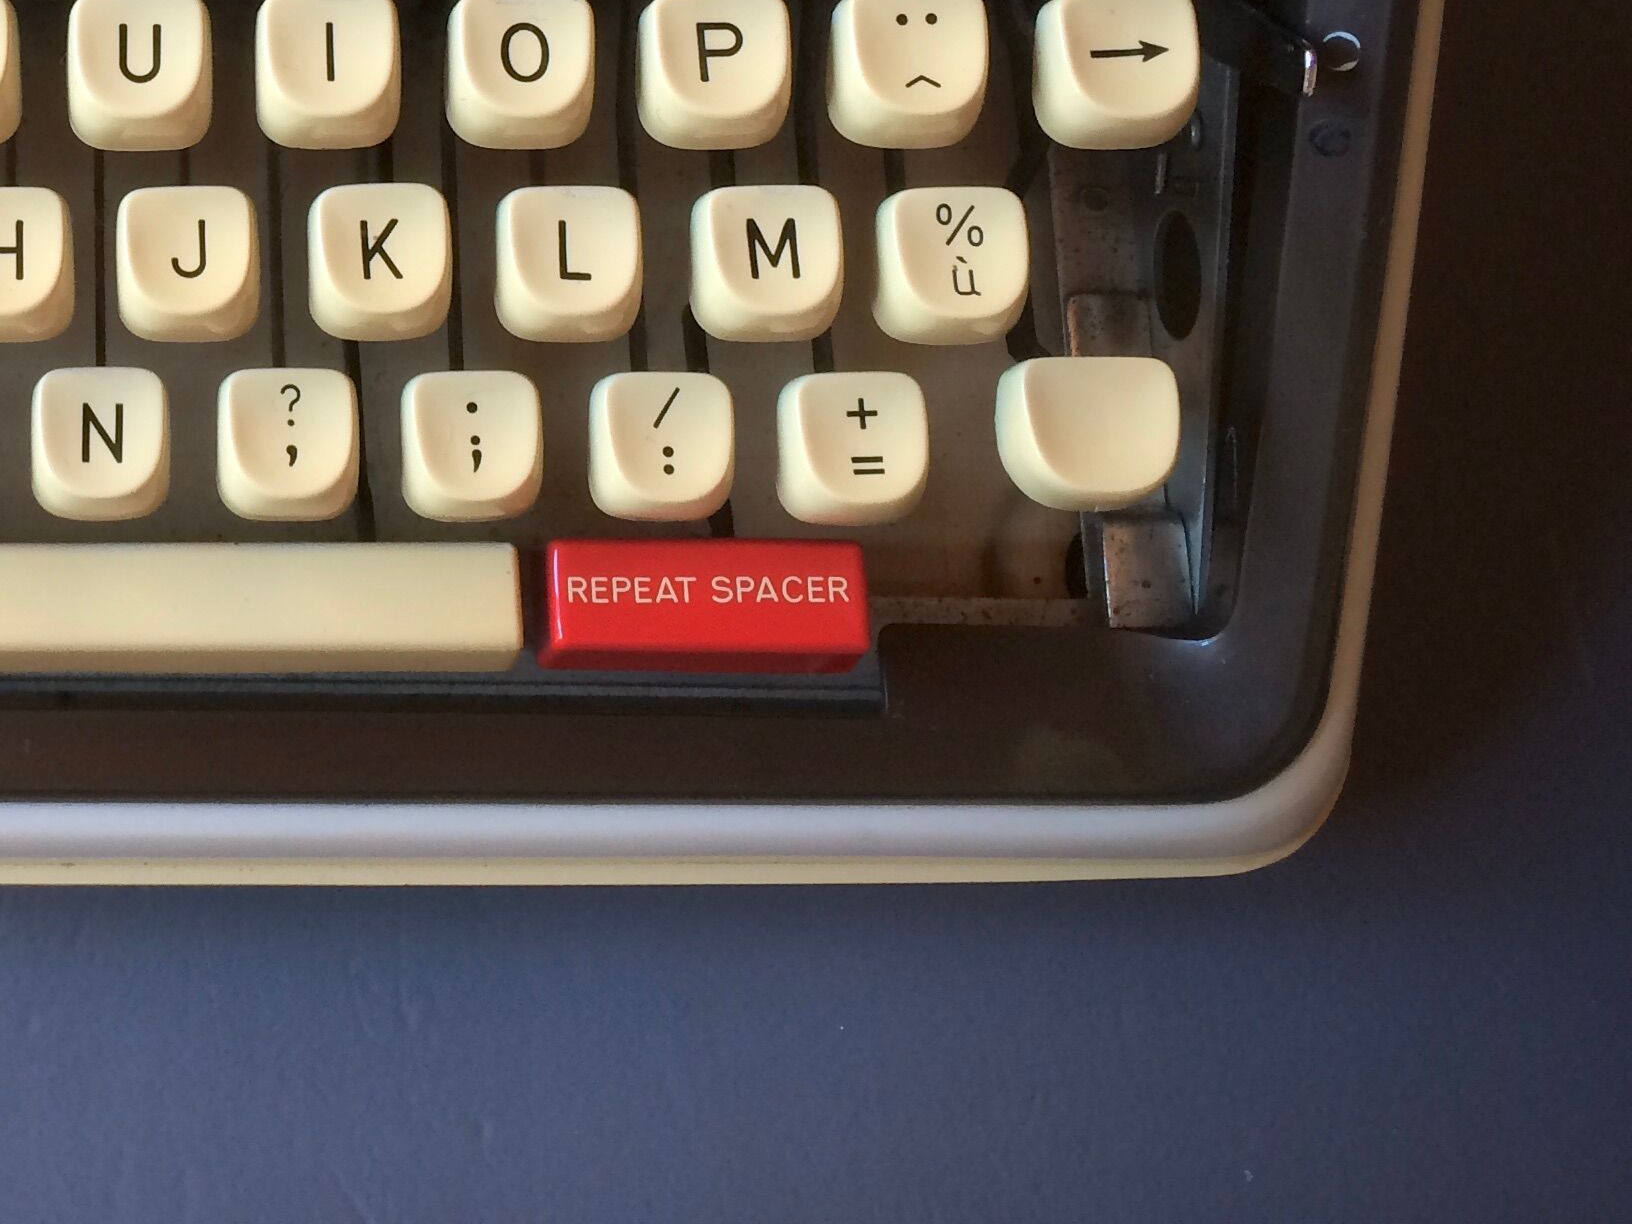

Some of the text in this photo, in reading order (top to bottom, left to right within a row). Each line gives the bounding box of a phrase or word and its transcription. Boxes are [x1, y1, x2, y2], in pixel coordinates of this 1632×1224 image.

[119, 24, 161, 83] U
[326, 22, 335, 81] I
[501, 23, 549, 82] O
[696, 22, 743, 82] P
[171, 219, 206, 278] J
[360, 218, 403, 280] K
[558, 220, 592, 281] L
[746, 218, 800, 279] M
[936, 203, 983, 247] %
[952, 256, 981, 296] ù
[82, 403, 123, 463] N
[280, 384, 300, 426] ?
[846, 398, 878, 429] +
[851, 456, 885, 475] =
[567, 575, 849, 604] REPEAT SPACER
